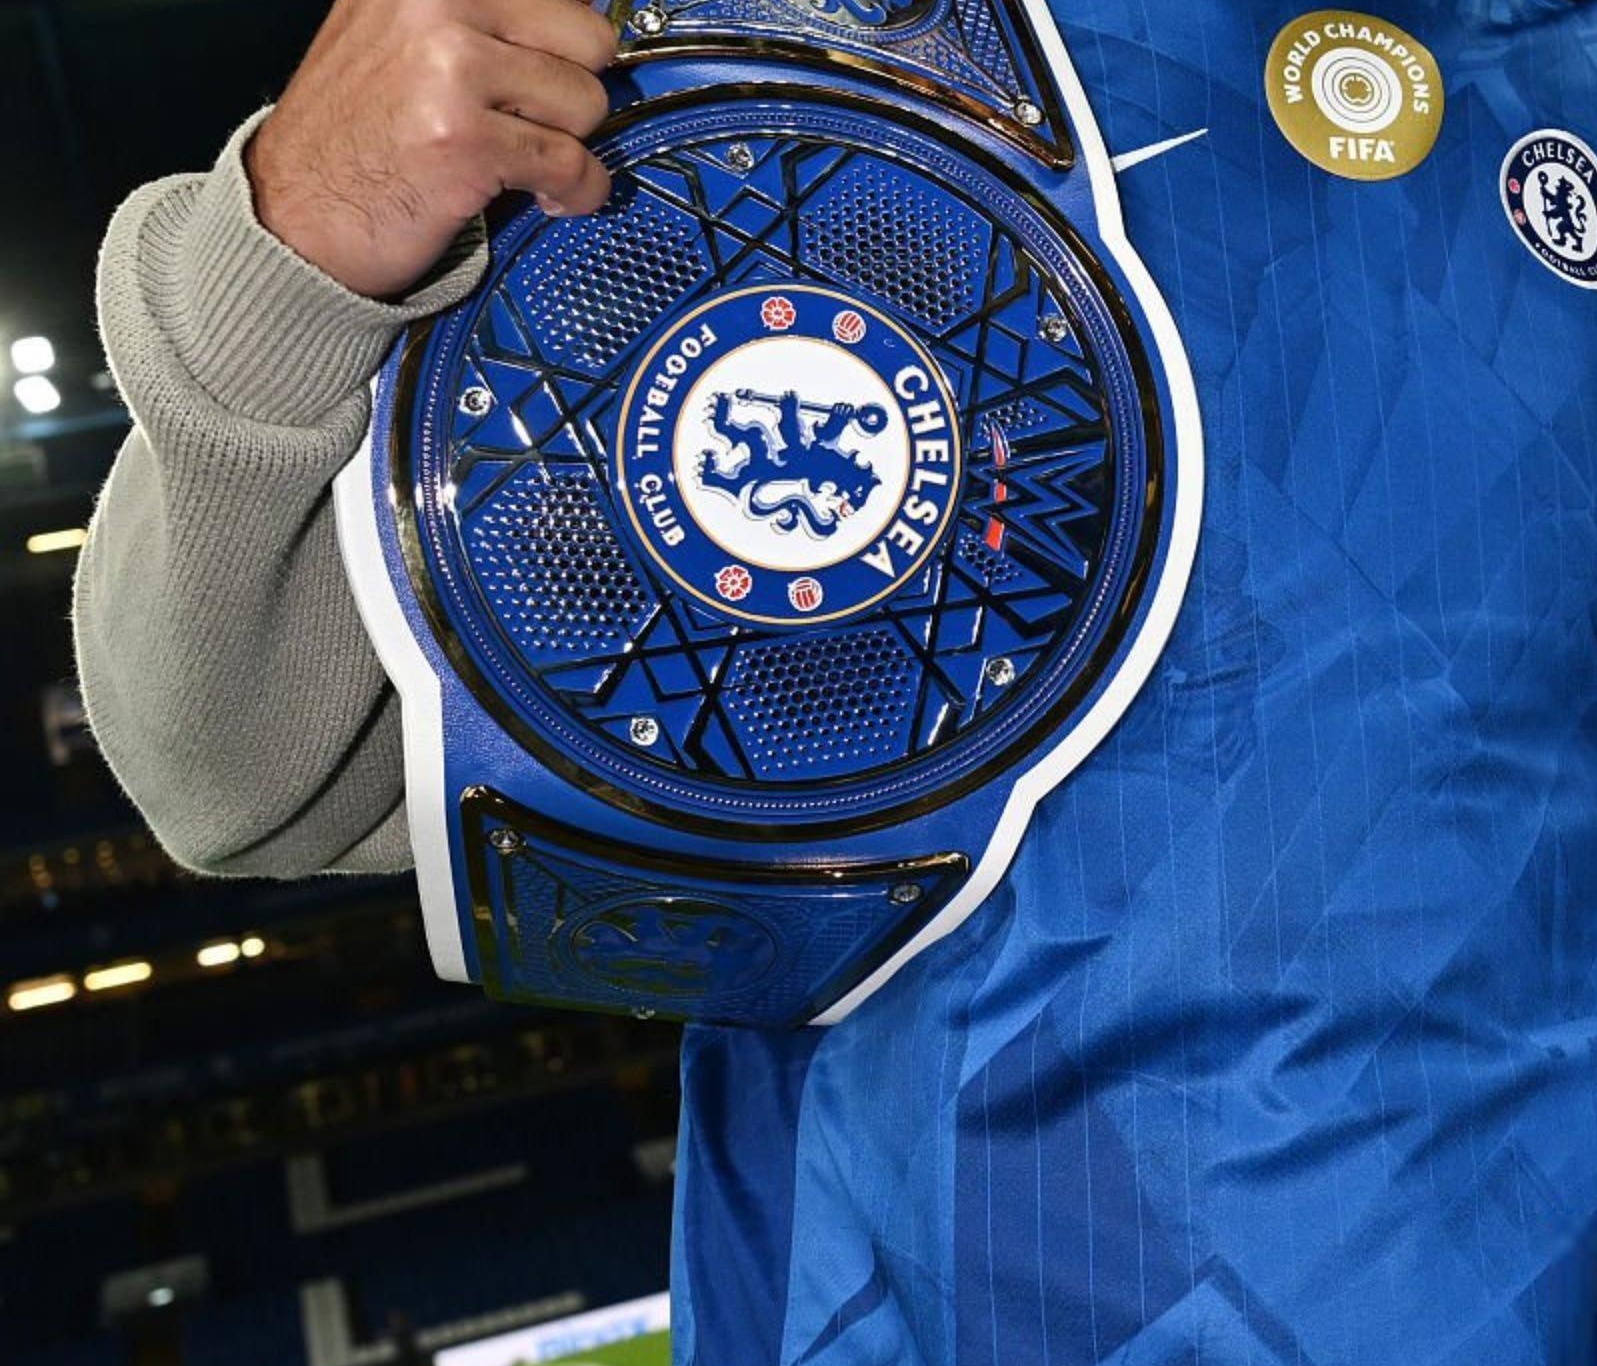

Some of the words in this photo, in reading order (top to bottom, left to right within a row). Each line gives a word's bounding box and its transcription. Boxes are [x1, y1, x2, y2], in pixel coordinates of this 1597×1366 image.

[1283, 30, 1322, 105] WORLD
[1324, 23, 1431, 115] CHAMPIONS
[1329, 136, 1396, 163] FIFA
[1521, 142, 1594, 184] CHELSEA
[636, 322, 719, 459] FOOTBALL
[639, 473, 686, 547] CLUB
[860, 365, 949, 579] CHELSEA
